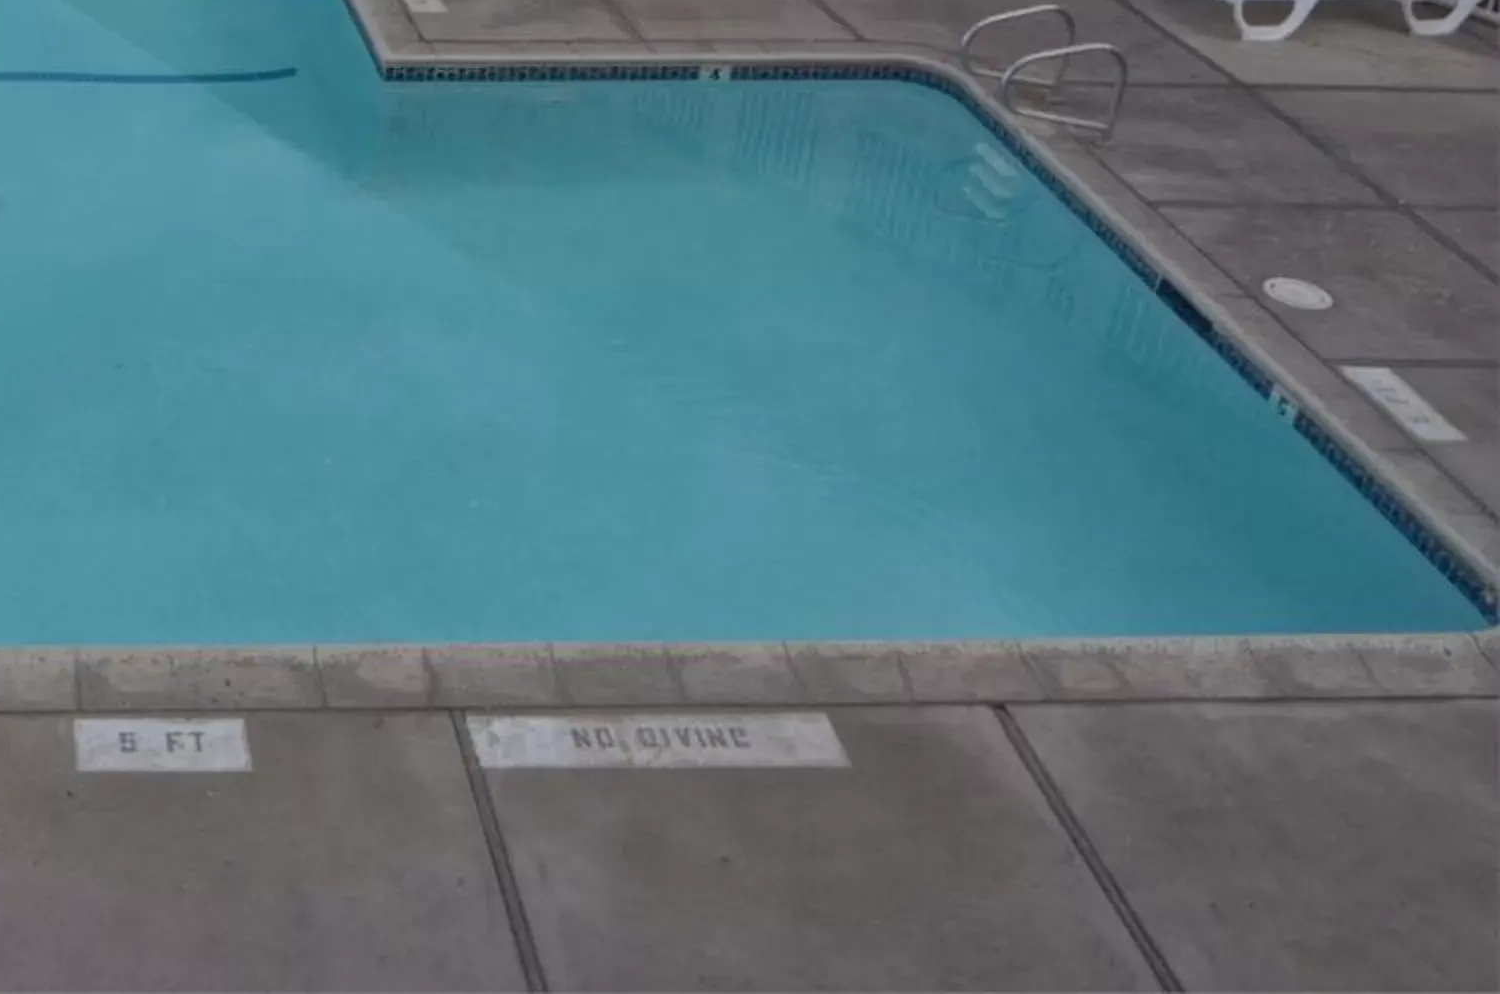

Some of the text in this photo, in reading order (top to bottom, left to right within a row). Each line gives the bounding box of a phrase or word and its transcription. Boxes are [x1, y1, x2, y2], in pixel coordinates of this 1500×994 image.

[118, 731, 206, 754] 5 FT
[570, 726, 752, 750] NO DIVING
